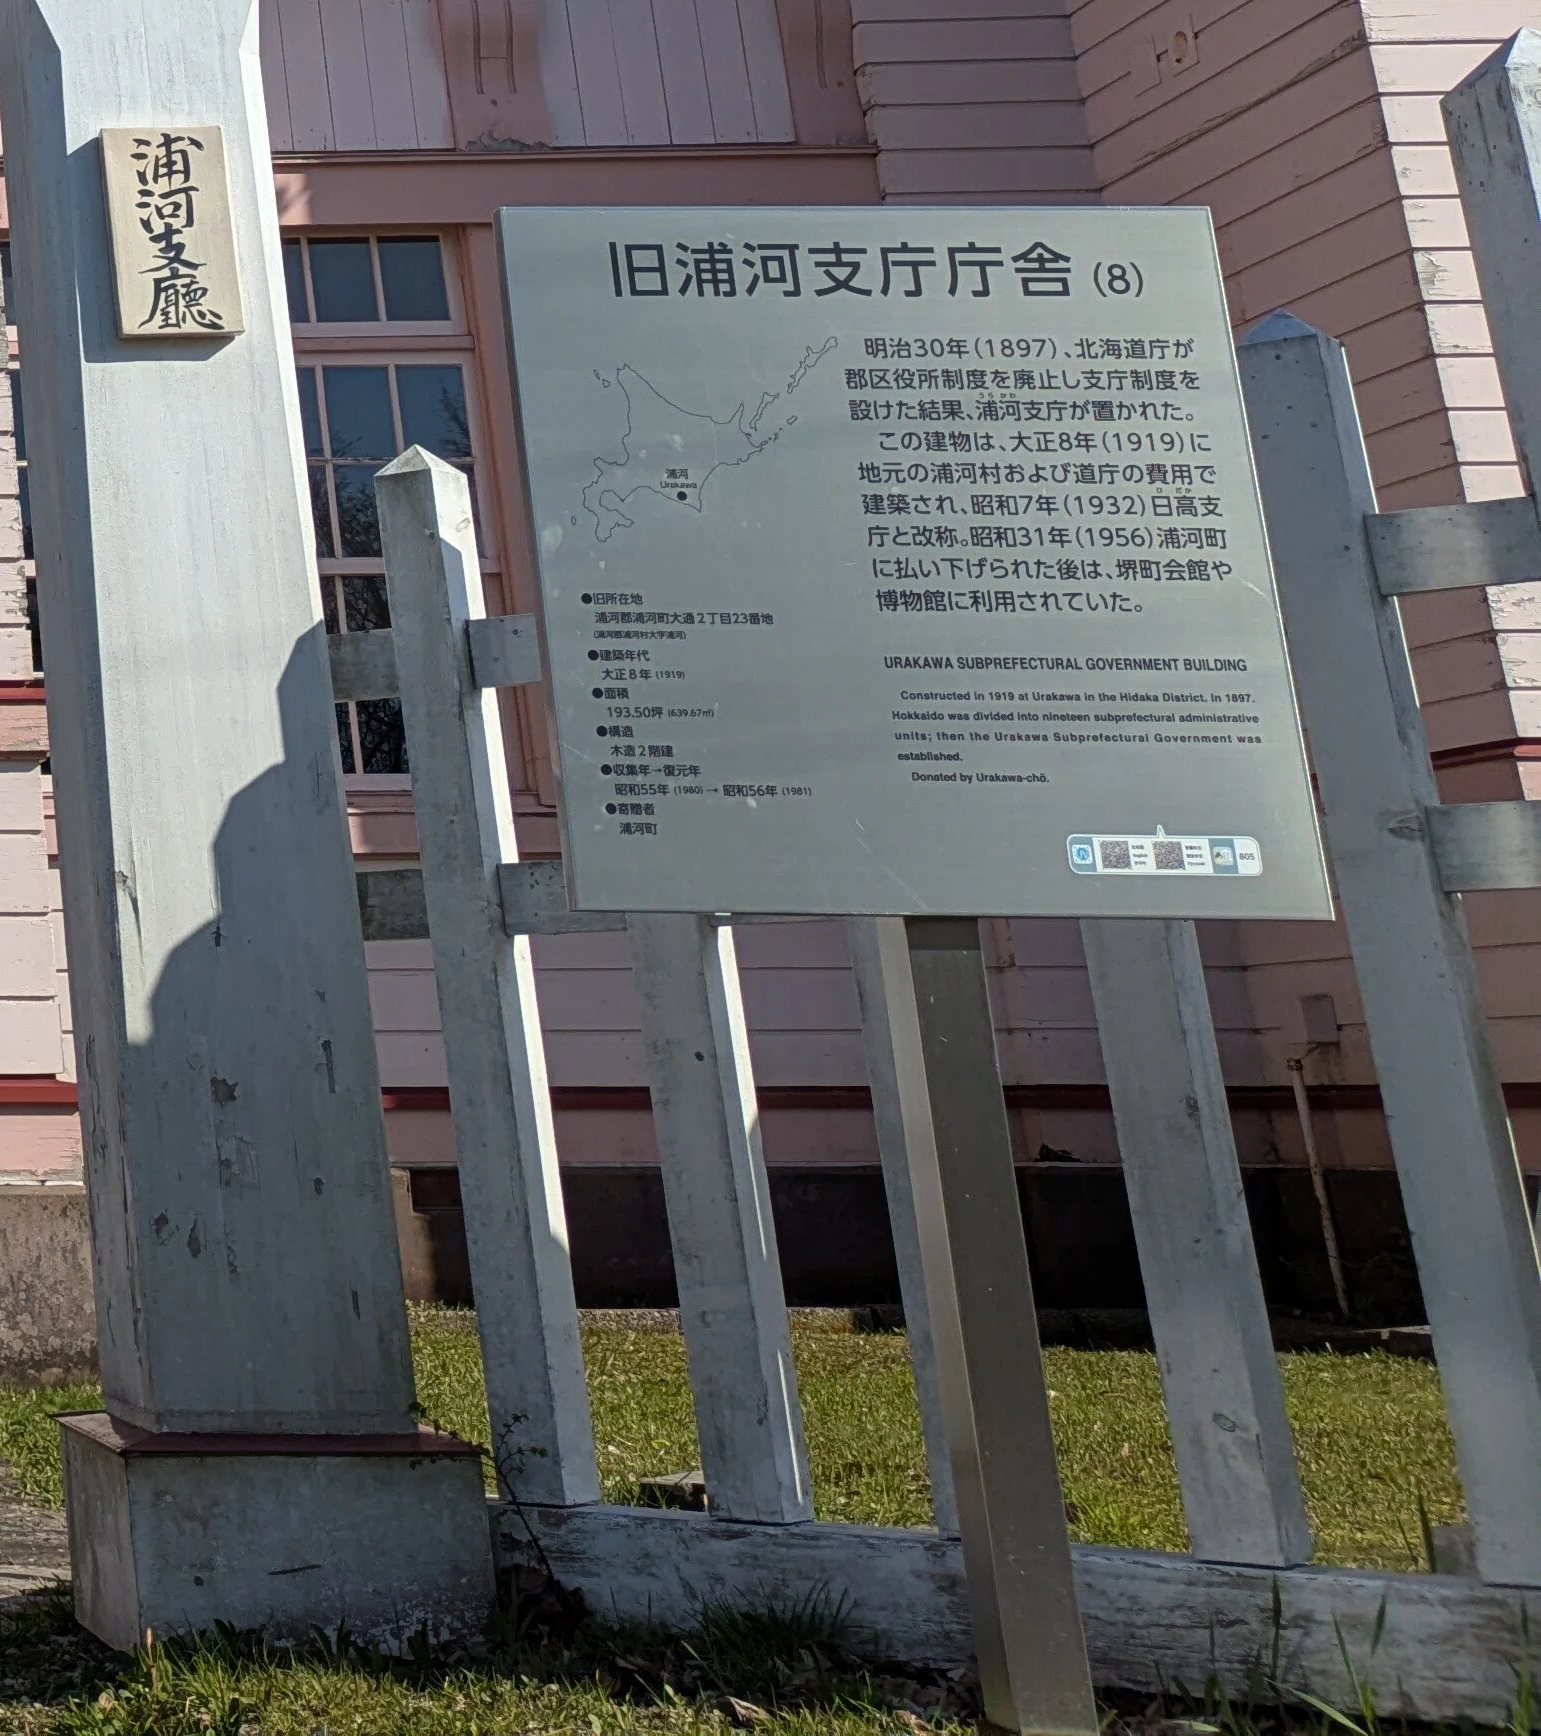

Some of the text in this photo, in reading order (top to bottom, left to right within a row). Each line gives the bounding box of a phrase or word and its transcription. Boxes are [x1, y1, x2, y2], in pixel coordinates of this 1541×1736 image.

[609, 242, 1143, 297] 旧浦河支庁庁舎 (8)
[844, 368, 1199, 390] 郡区役所制度を廃止し支庁制度を
[849, 400, 1193, 421] 設けた結果、浦河支庁が置かれた。
[858, 462, 1216, 485] 地元の浦河村および道庁の費用で
[873, 557, 1232, 581] に払い下げられた後は、堺町会館や
[876, 589, 1142, 612] 博物館に利用されていた。
[884, 656, 1247, 671] URAKAWA SUBPREFECTURAL GOVERNMENT BUILDING
[901, 691, 970, 700] Constructed
[974, 691, 984, 700] in
[989, 692, 1014, 701] 1919
[1018, 693, 1028, 701] at
[1032, 692, 1080, 701] Urakawa
[1084, 692, 1095, 701] in
[1098, 693, 1116, 701] the
[1120, 693, 1159, 702] Hidaka
[892, 711, 944, 720] Hokkaido
[973, 712, 1014, 721] divided
[1018, 712, 1039, 721] into
[1042, 712, 1090, 721] nineteen
[1094, 713, 1175, 724] subprefectural
[1179, 713, 1258, 723] administrative
[937, 732, 964, 740] then
[970, 732, 989, 741] the
[995, 732, 1048, 741] Urakawa
[1054, 732, 1148, 743] Subprefectural
[1154, 733, 1232, 743] Government
[898, 752, 962, 761] established.
[912, 772, 956, 781] Donated
[960, 773, 972, 784] by
[1239, 852, 1255, 861] 805
